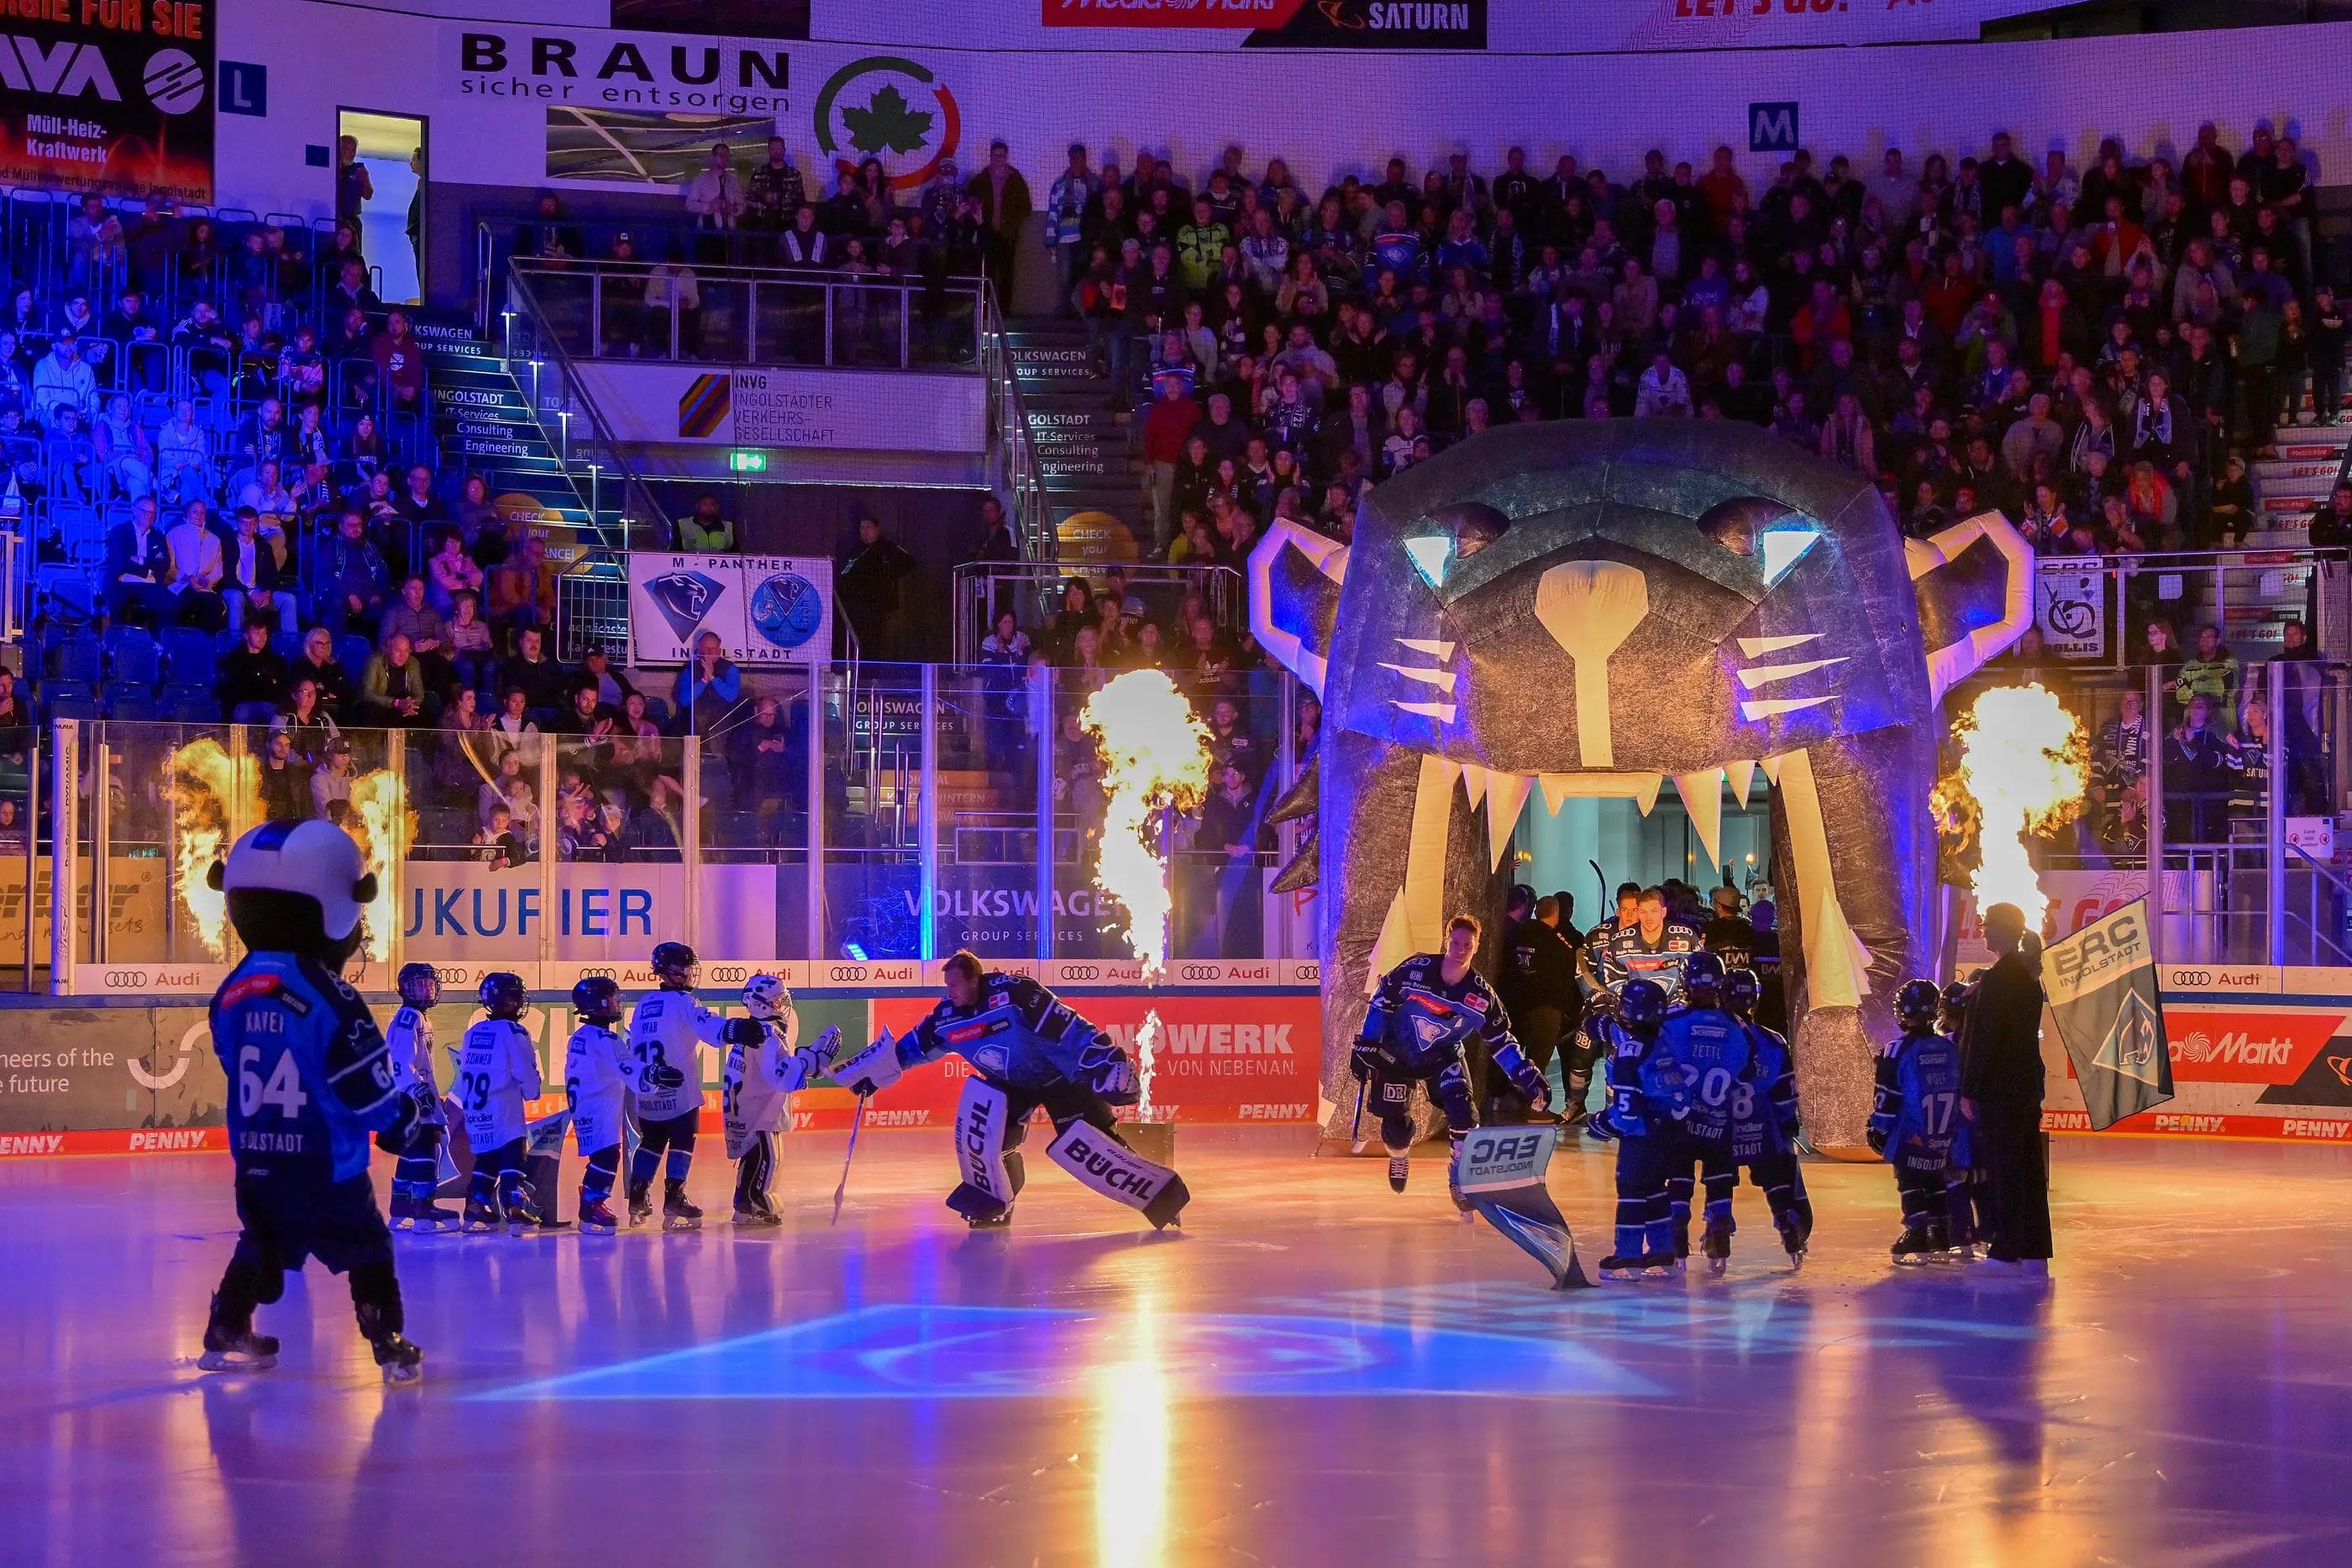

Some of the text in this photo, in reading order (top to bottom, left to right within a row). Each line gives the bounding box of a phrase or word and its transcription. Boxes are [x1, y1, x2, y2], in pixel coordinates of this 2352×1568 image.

[153, 0, 202, 39] SIE
[1369, 3, 1468, 30] SATURN
[461, 33, 790, 89] BRAUN
[234, 70, 253, 109] L
[461, 76, 790, 113] sicher entsorgen
[27, 114, 107, 139] Müll-Heiz-
[1754, 109, 1793, 144] M
[27, 139, 107, 164] Kraftwerk
[415, 324, 472, 340] KSWAGEN
[438, 344, 481, 355] SERVICES
[735, 375, 767, 389] INVG
[1028, 415, 1090, 425] GOLSTADT
[457, 422, 513, 439] Consulting
[734, 427, 835, 443] GESELLSCHAFT
[1037, 431, 1095, 441] IT-Services
[465, 440, 528, 458] Engineering
[1037, 445, 1099, 458] Consulting
[1040, 461, 1104, 475] ngineering
[509, 511, 545, 522] CHECK
[1073, 529, 1112, 539] CHECK
[544, 548, 575, 559] ANCE!
[1082, 545, 1108, 557] your
[673, 557, 794, 571] M PANTHER
[855, 721, 954, 731] GROUP SERCES
[961, 931, 1083, 941] GROUP SERICES
[2052, 915, 2139, 976] ERC
[155, 972, 201, 986] Audi
[874, 968, 913, 980] Audi
[1107, 968, 1142, 979] Aud
[1228, 967, 1269, 979] Audi
[2218, 973, 2260, 986] Audi
[1105, 1024, 1294, 1054] NDWERK
[57, 1048, 77, 1067] of
[83, 1048, 114, 1067] the
[944, 1062, 969, 1078] DIE
[1168, 1060, 1298, 1076] VON NEBENAN.
[9, 1074, 70, 1093] future
[239, 1045, 307, 1119] 64
[1921, 1093, 1955, 1135] 17
[968, 1099, 993, 1193] BÜCHL
[1063, 1137, 1156, 1201] BÜCHL
